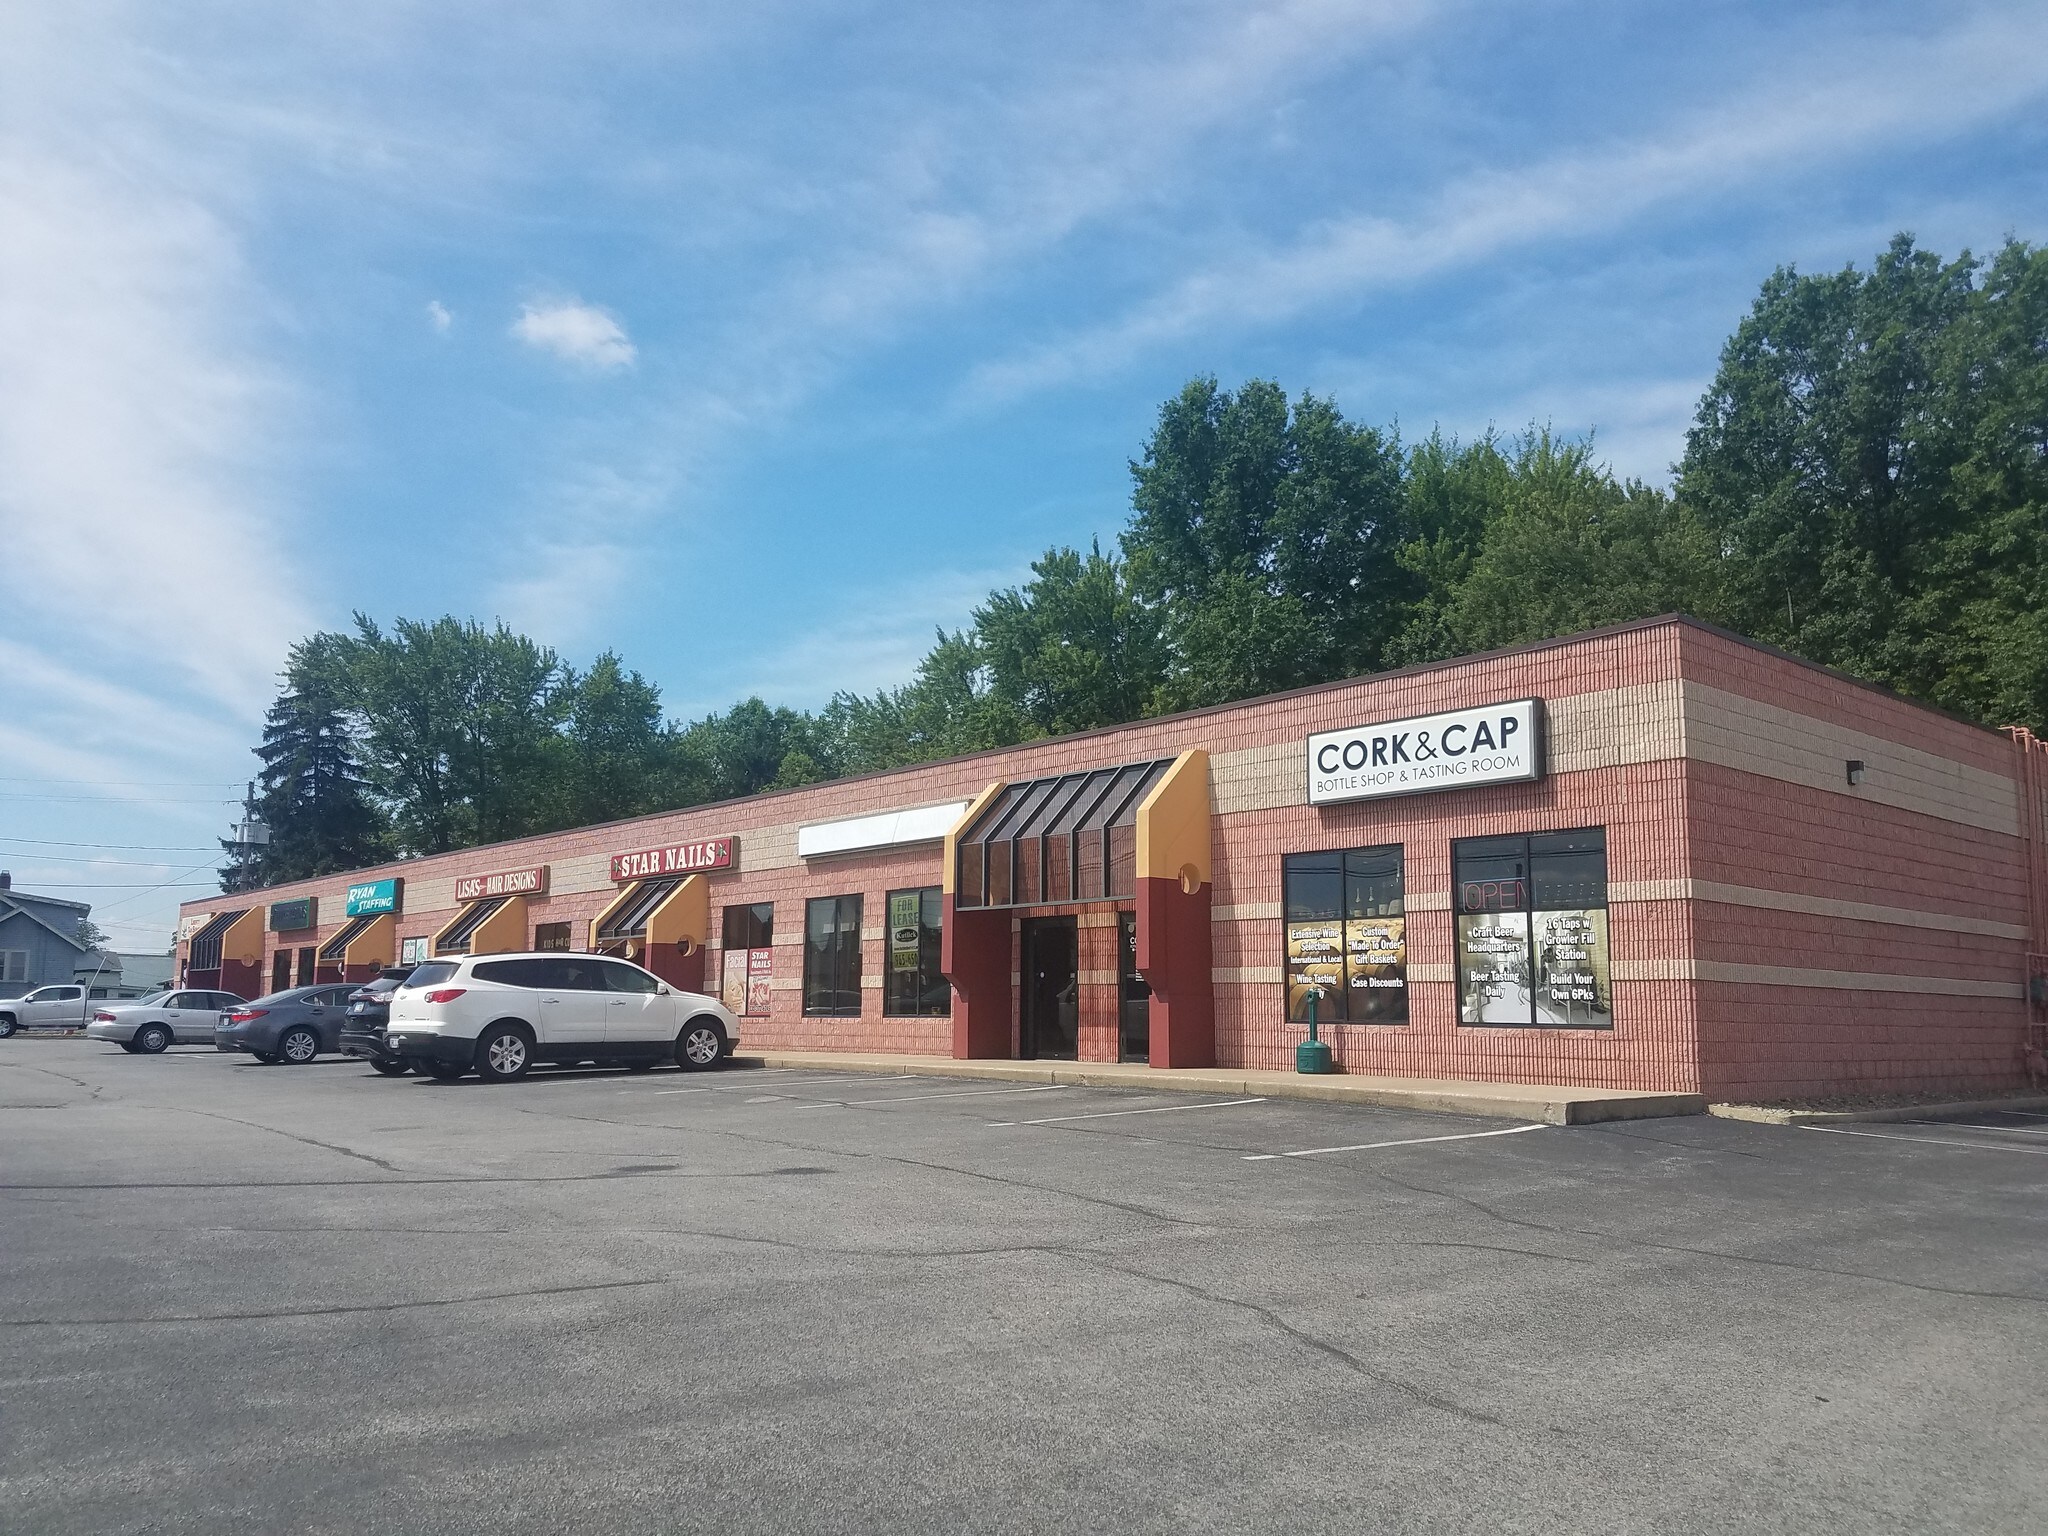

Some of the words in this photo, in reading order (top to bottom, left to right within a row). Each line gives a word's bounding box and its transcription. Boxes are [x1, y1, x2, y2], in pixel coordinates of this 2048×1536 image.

[1317, 776, 1358, 793] BOTTLE
[1360, 771, 1395, 787] SHOP
[1399, 770, 1409, 782] &
[1413, 761, 1467, 780] TASTING
[1471, 754, 1520, 773] ROOM
[621, 851, 661, 877] STAR
[665, 842, 716, 871] NAILS
[457, 878, 481, 899] LISA'S
[486, 875, 503, 895] HAIR
[503, 870, 537, 892] DESIGNS
[347, 885, 377, 903] RYAN
[1465, 880, 1527, 910] OPEN
[357, 896, 393, 913] STAFFING
[897, 899, 913, 912] FOR
[892, 911, 919, 926] LEASE
[1547, 918, 1558, 930] 16
[1560, 918, 1581, 930] Taps
[1582, 916, 1594, 930] w/
[1291, 928, 1322, 940] Extensive
[1322, 928, 1339, 939] Wine
[1362, 926, 1388, 937] Custom
[1472, 926, 1492, 938] Craft
[1494, 926, 1514, 937] Beer
[1371, 940, 1380, 950] To
[1545, 933, 1578, 945] Growler
[1581, 933, 1595, 944] Fill
[1300, 941, 1330, 952] Selection
[1467, 941, 1521, 954] Headquarters
[751, 951, 769, 960] STAR
[1290, 955, 1322, 964] International
[1328, 954, 1342, 964] Local
[1355, 954, 1369, 964] Gift
[1370, 954, 1398, 964] Baskets
[1555, 949, 1587, 960] Station
[726, 953, 747, 969] Facial
[751, 960, 772, 969] NAILS
[1296, 974, 1313, 984] Wine
[1314, 974, 1336, 985] Tasting
[1351, 978, 1368, 988] Case
[1369, 977, 1404, 988] Discounts
[1470, 971, 1489, 982] Beer
[1490, 970, 1520, 984] Tasting
[1550, 974, 1572, 985] Build
[1574, 974, 1594, 985] Your
[1485, 985, 1506, 998] Daily
[1551, 989, 1570, 1000] Own
[1571, 988, 1594, 1000] 6Pks
